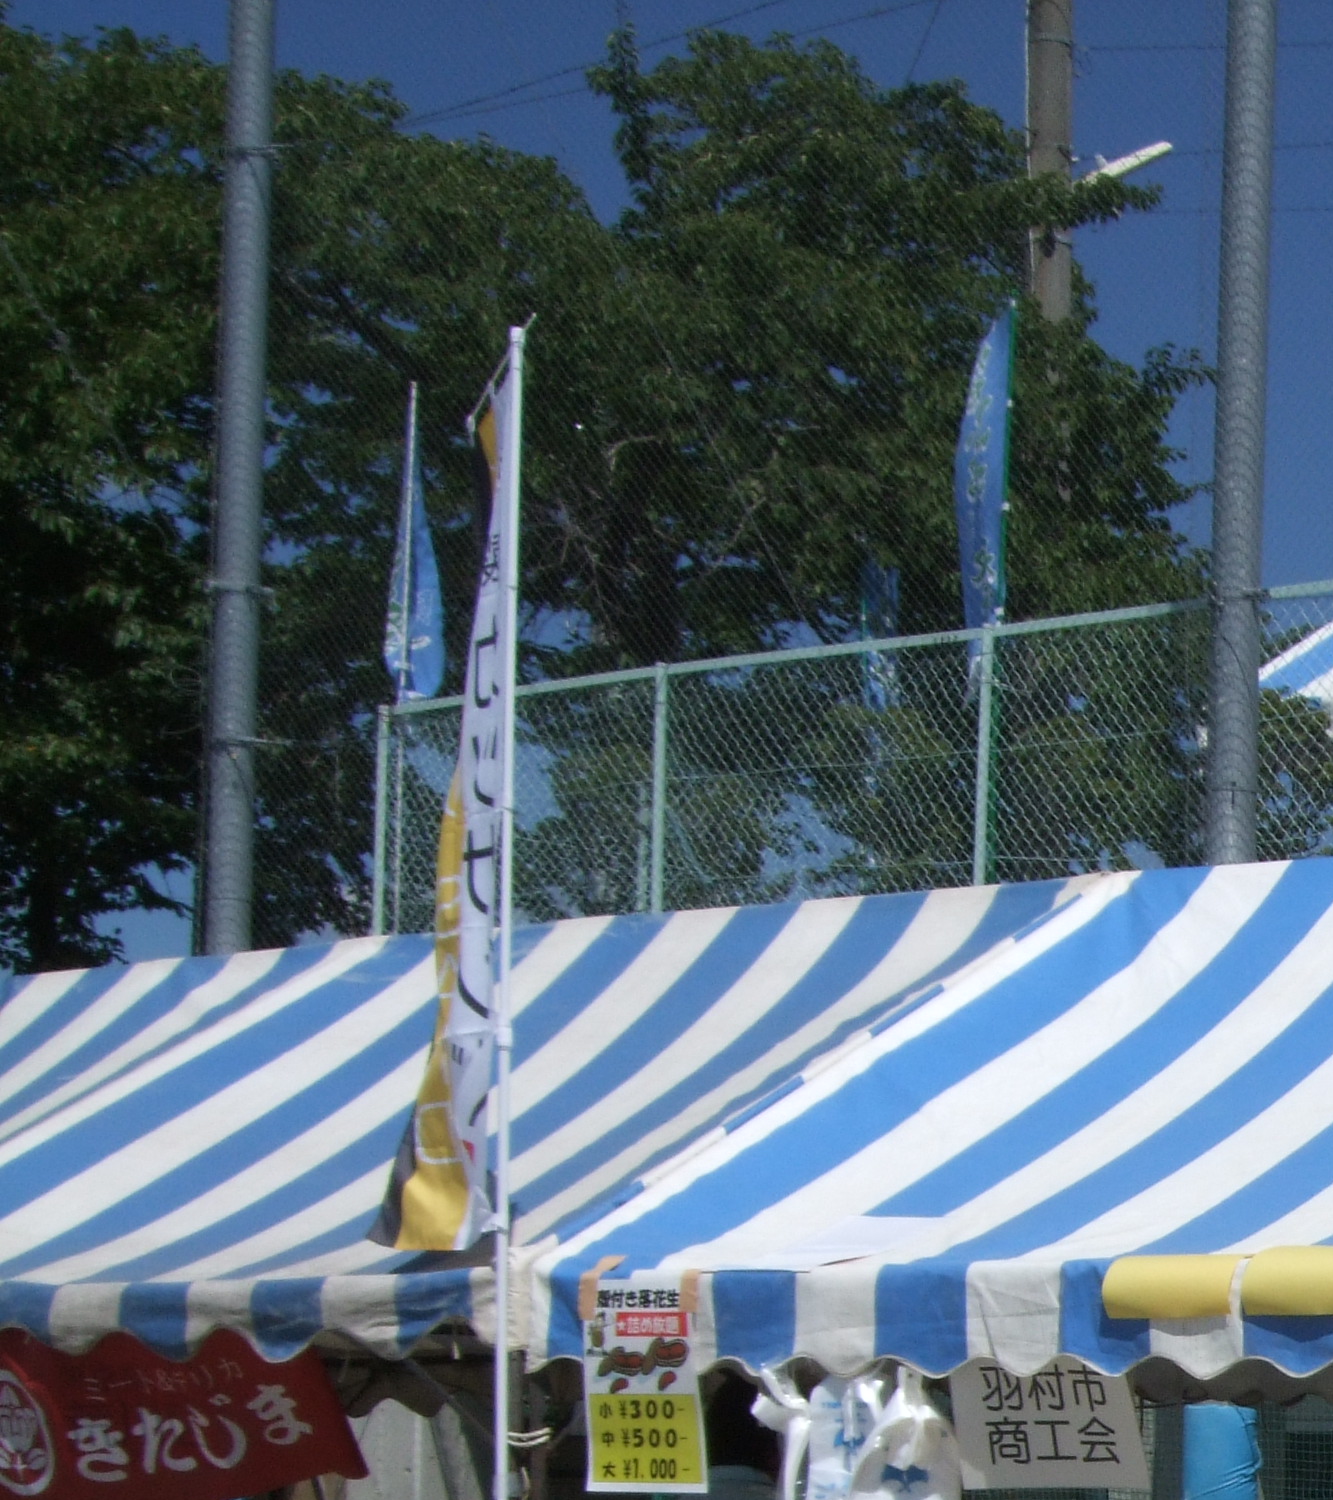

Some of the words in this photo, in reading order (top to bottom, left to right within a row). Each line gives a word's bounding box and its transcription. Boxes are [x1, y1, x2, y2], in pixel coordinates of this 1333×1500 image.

[979, 1364, 1106, 1412] 羽村市
[68, 1384, 313, 1483] きたじま
[985, 1416, 1121, 1465] 商工会
